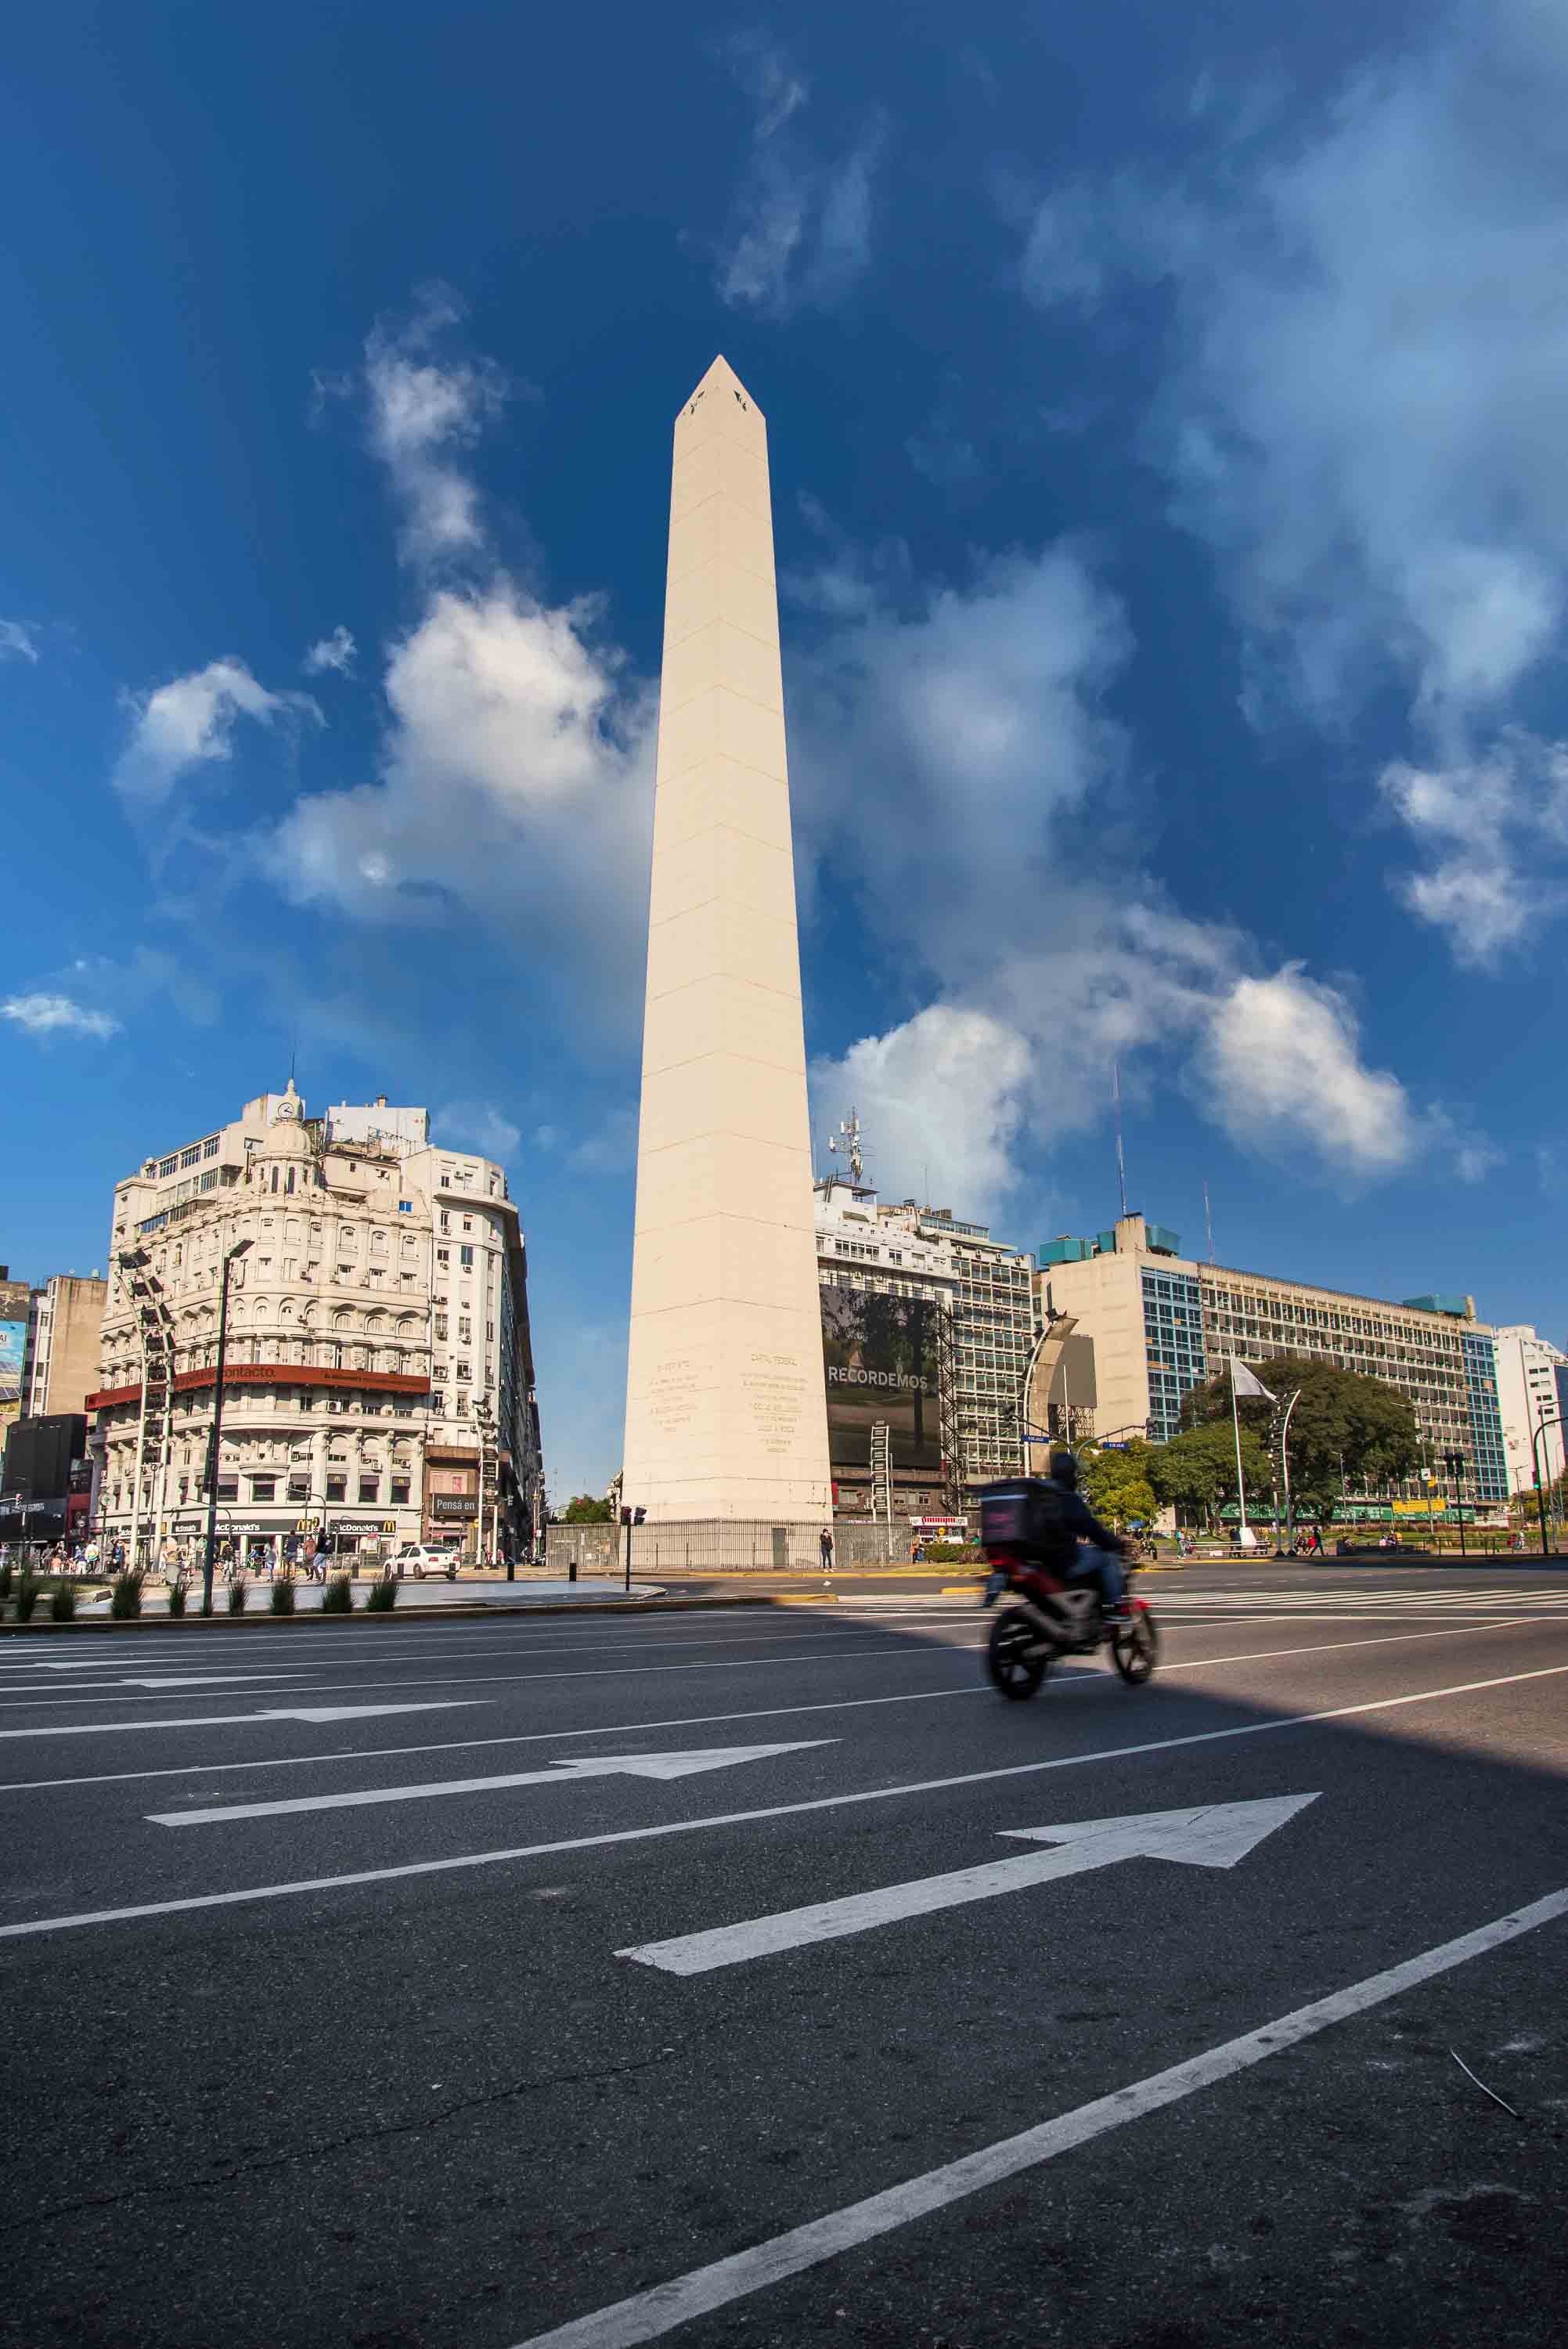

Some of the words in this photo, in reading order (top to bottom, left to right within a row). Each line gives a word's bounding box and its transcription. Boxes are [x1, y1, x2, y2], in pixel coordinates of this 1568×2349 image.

[223, 1365, 276, 1378] ontacto.
[828, 1366, 928, 1390] RECORDEMOS
[437, 1499, 463, 1510] Pensá
